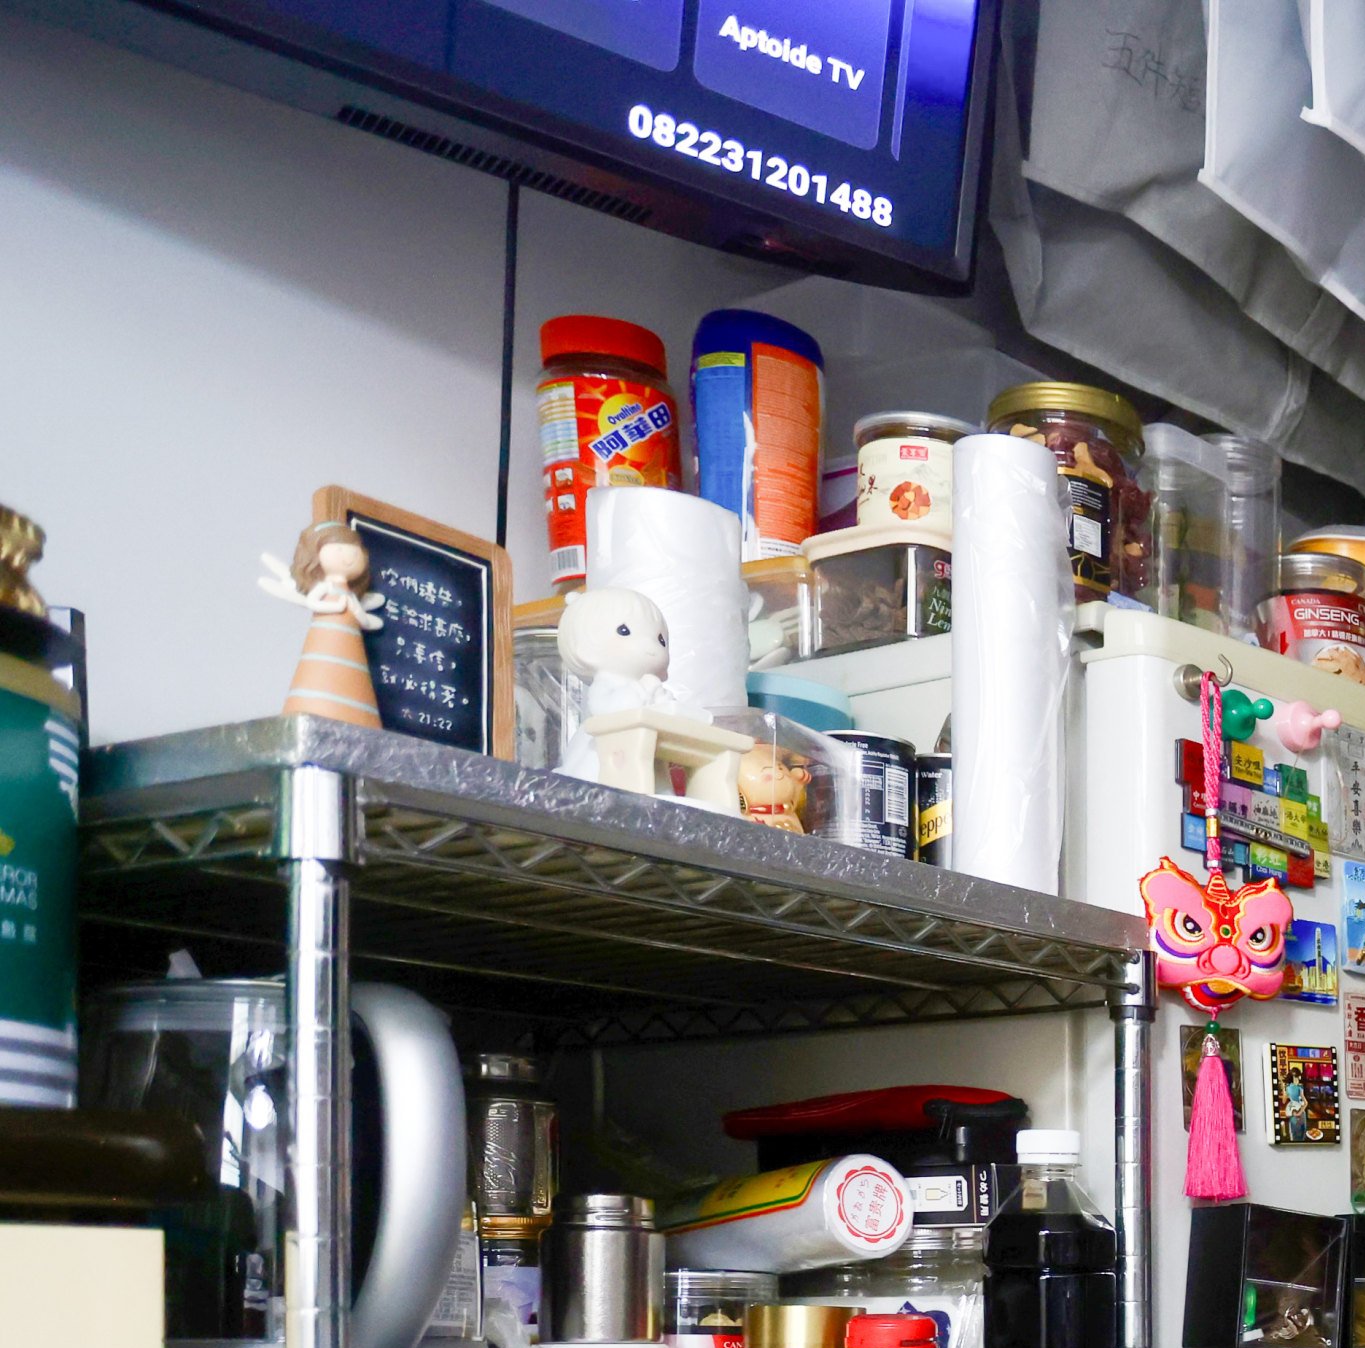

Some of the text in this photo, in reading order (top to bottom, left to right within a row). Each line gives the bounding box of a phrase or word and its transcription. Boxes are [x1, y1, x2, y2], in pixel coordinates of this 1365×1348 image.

[719, 14, 865, 90] Aptoide TV
[628, 104, 893, 227] 082231201488
[590, 402, 671, 460] 阿華田
[607, 402, 642, 425] Ovaltine
[1294, 608, 1360, 626] GINSENG
[418, 712, 453, 730] 21:22
[979, 1170, 990, 1217] つめ替用
